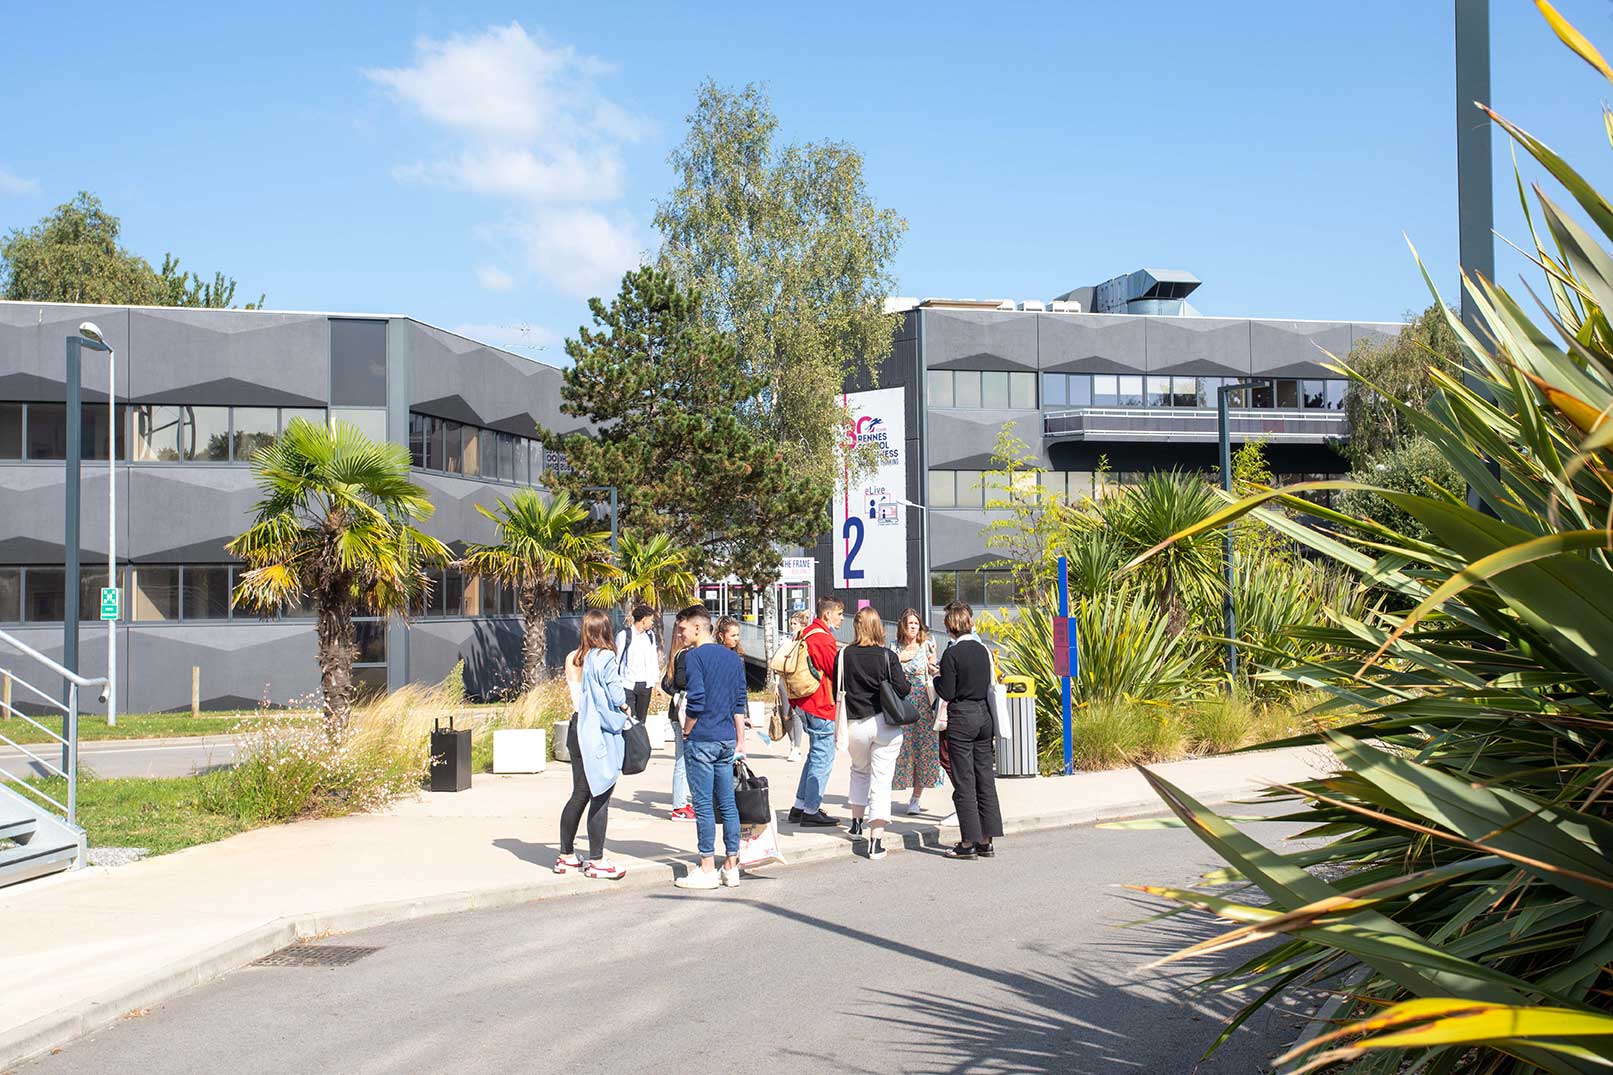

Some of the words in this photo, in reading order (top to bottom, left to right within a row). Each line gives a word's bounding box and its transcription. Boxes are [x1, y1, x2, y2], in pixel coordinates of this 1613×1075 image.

[857, 432, 888, 442] RENNES
[865, 486, 886, 495] eLive
[843, 516, 865, 579] 2
[784, 559, 792, 568] HE
[792, 559, 811, 568] FRAME
